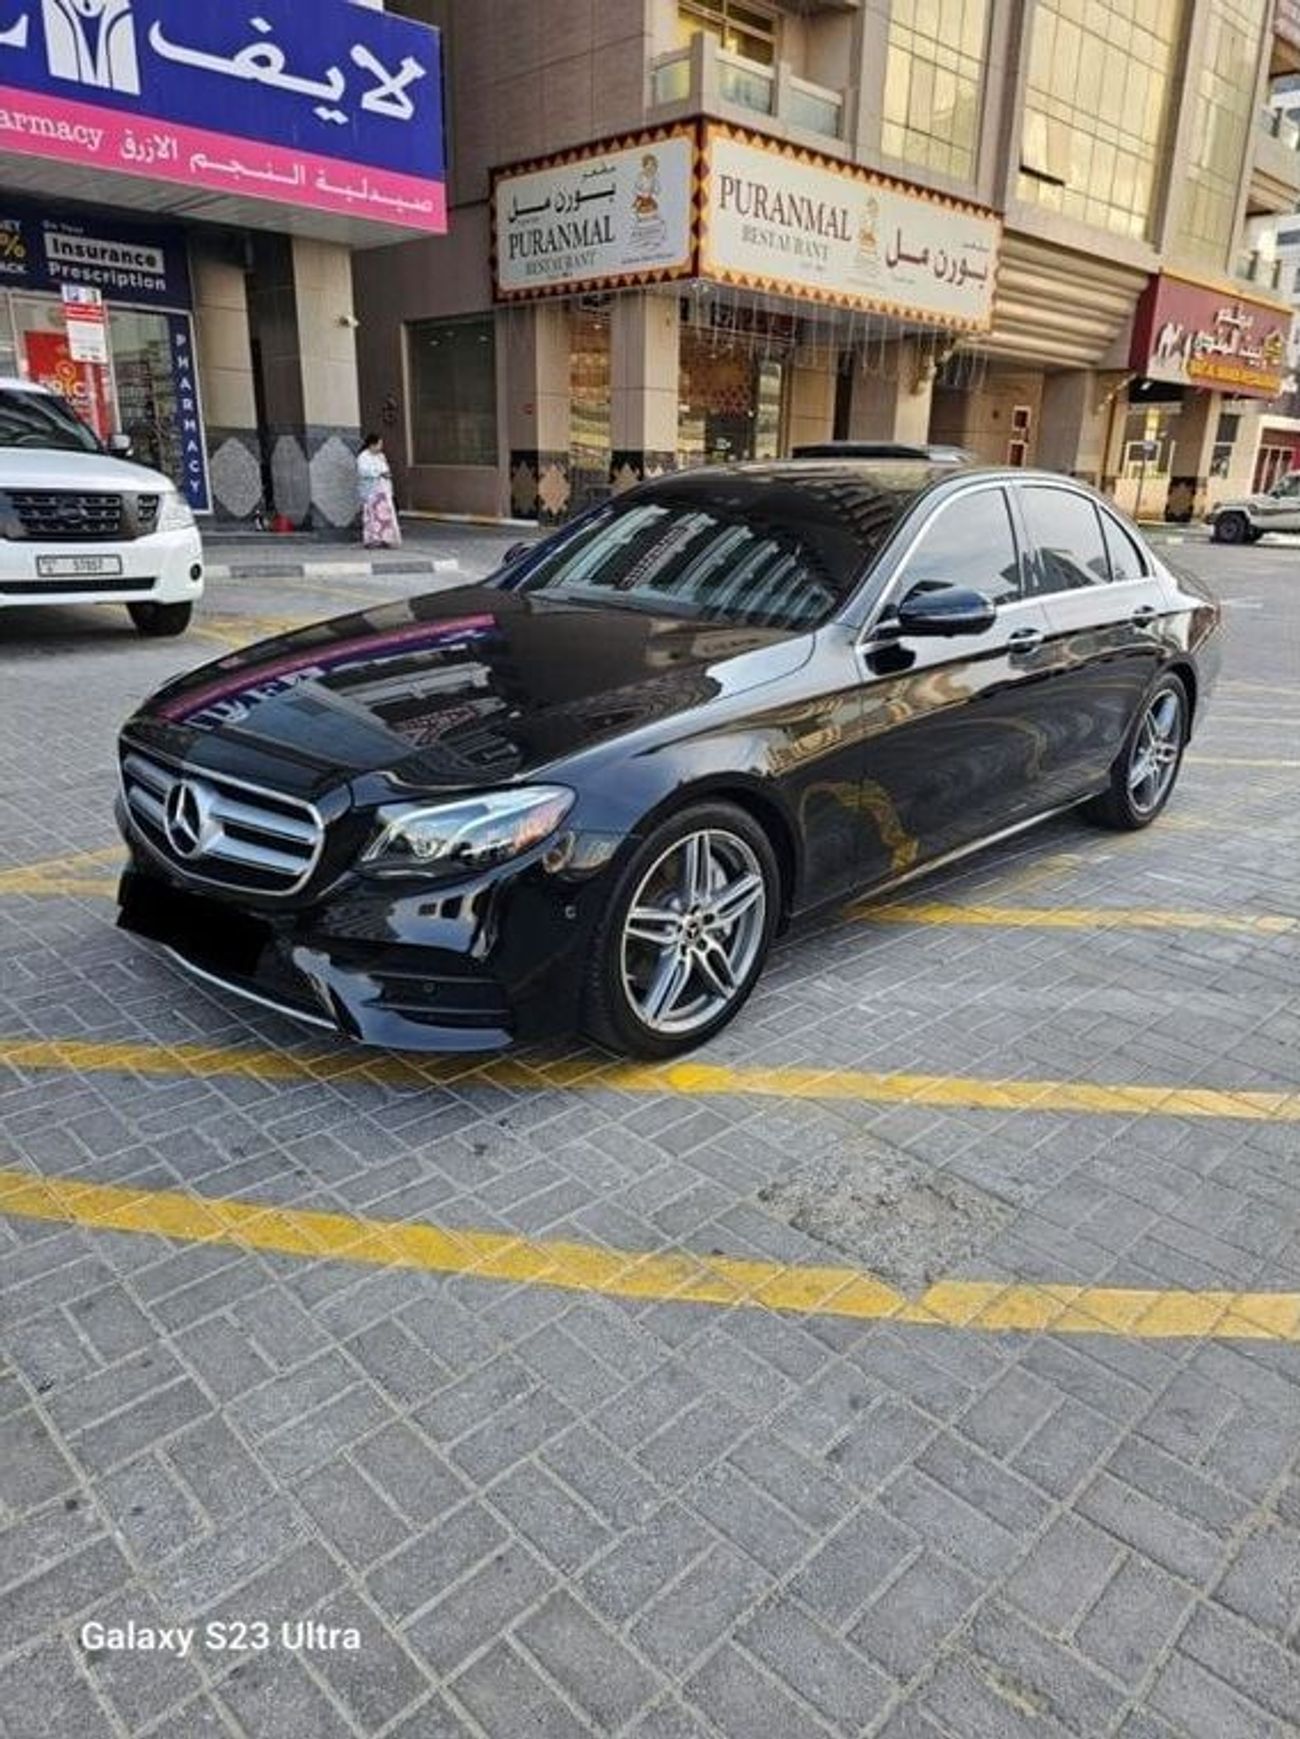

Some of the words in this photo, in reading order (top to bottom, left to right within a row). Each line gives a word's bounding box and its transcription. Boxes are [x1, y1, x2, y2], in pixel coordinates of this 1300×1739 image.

[148, 17, 427, 125] لايف
[190, 150, 305, 186] النجم
[315, 168, 433, 213] صيدلية
[719, 174, 852, 242] PURANMAL
[52, 237, 157, 268] Insurance
[509, 214, 616, 260] PURANMAL
[50, 262, 166, 291] Prescription
[175, 333, 200, 493] PHARMACY
